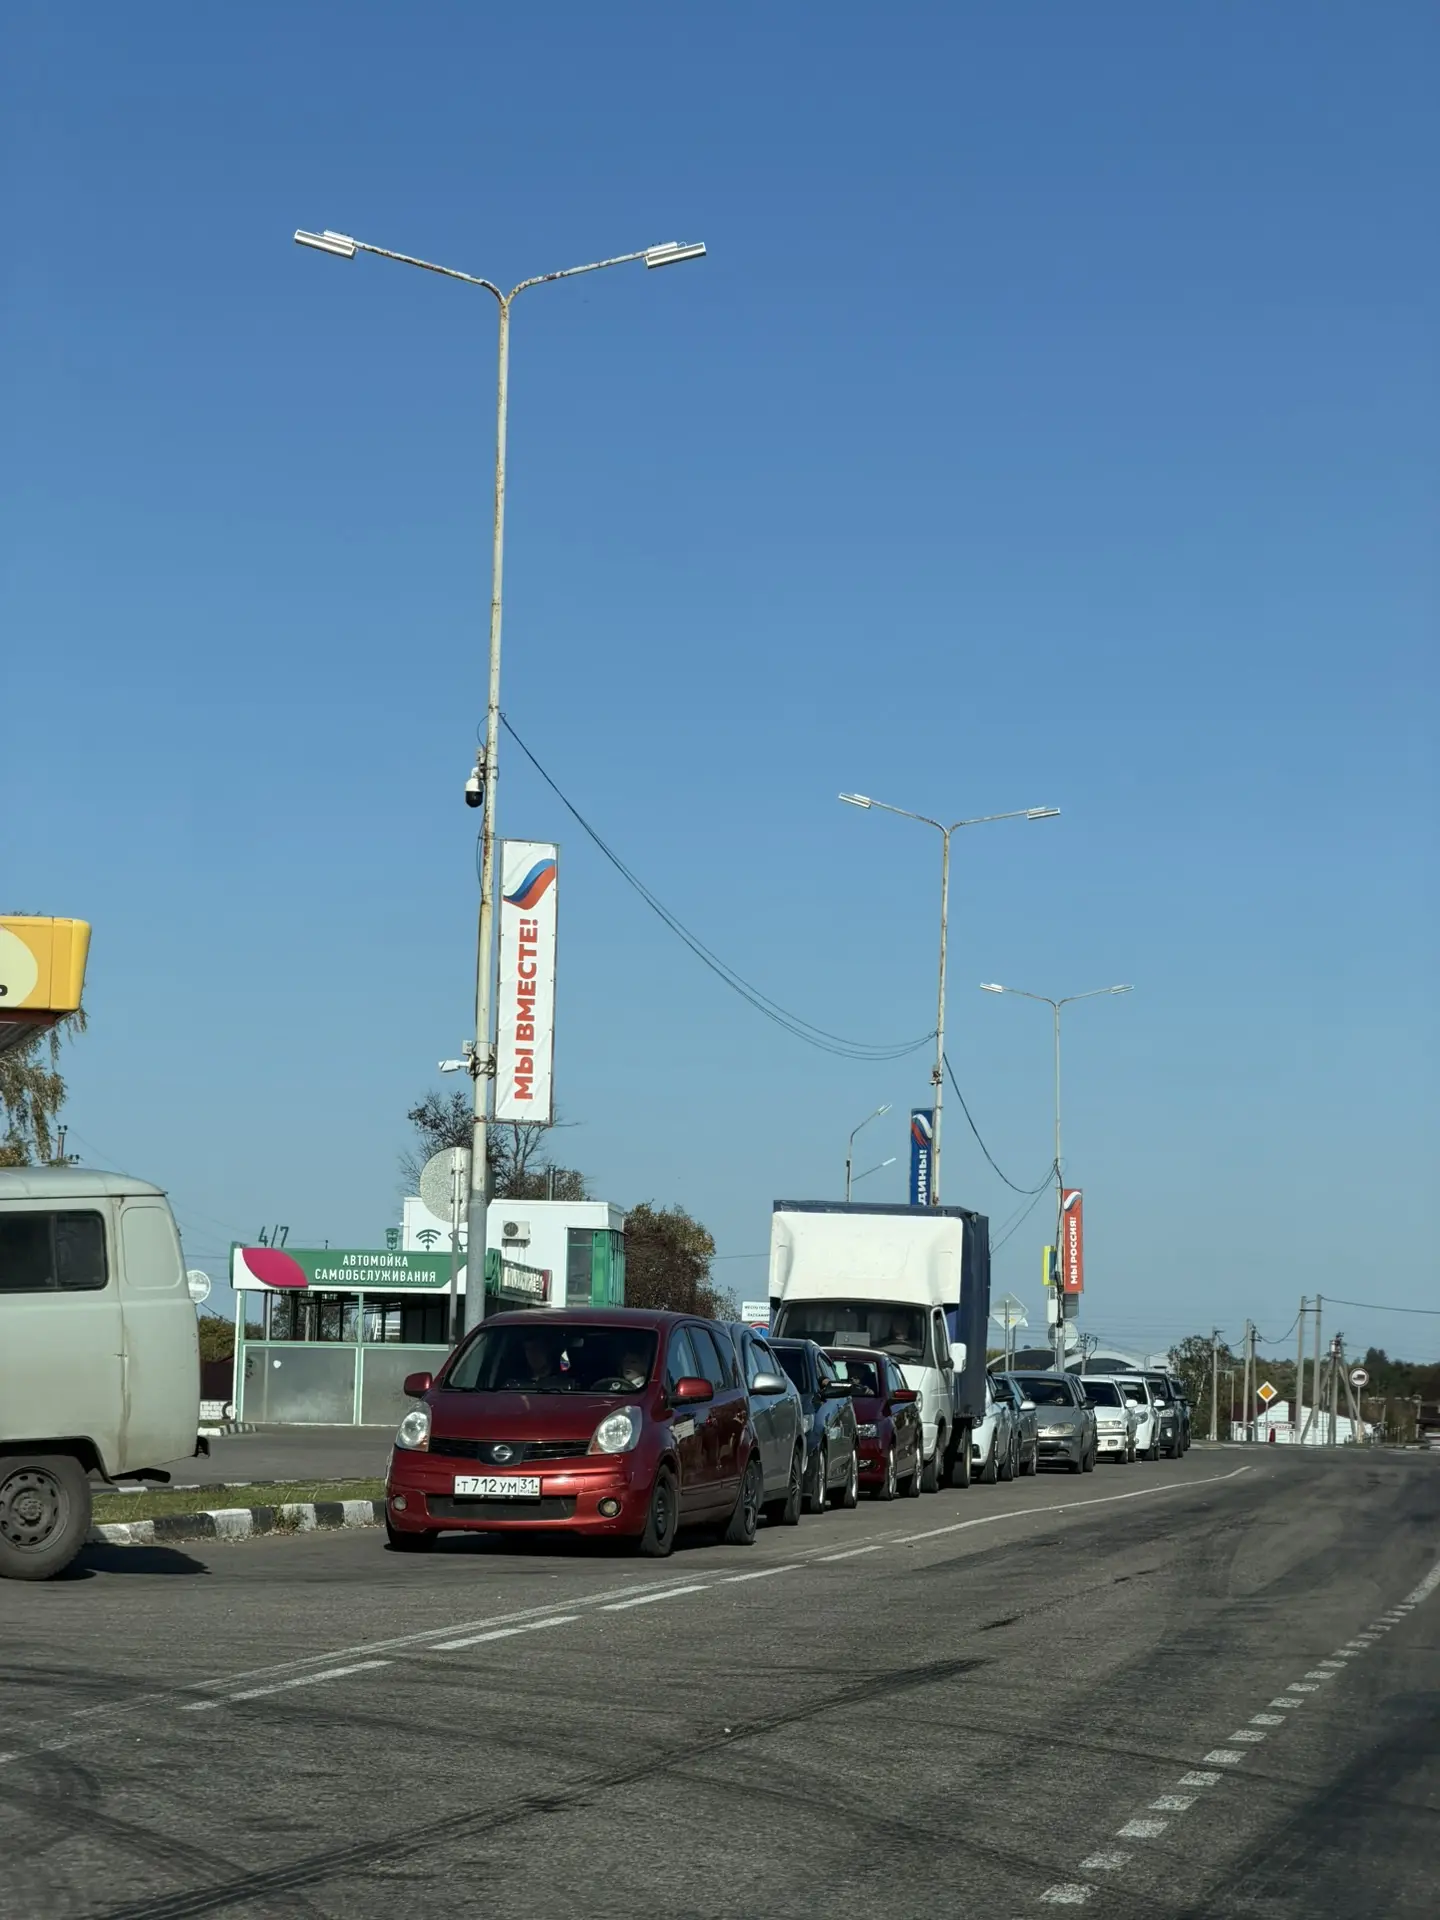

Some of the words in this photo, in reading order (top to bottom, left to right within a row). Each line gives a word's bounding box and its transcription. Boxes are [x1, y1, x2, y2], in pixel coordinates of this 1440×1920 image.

[515, 918, 538, 1041] ВМЕСТЕ!
[514, 1048, 534, 1099] МЫ
[1069, 1216, 1077, 1263] РОССИЯ!
[342, 1252, 408, 1267] АВТОМОЙКА
[314, 1269, 436, 1283] САМООБСЛУЖИВАНИЯ
[1070, 1265, 1078, 1285] МЫ
[520, 1479, 534, 1490] 31
